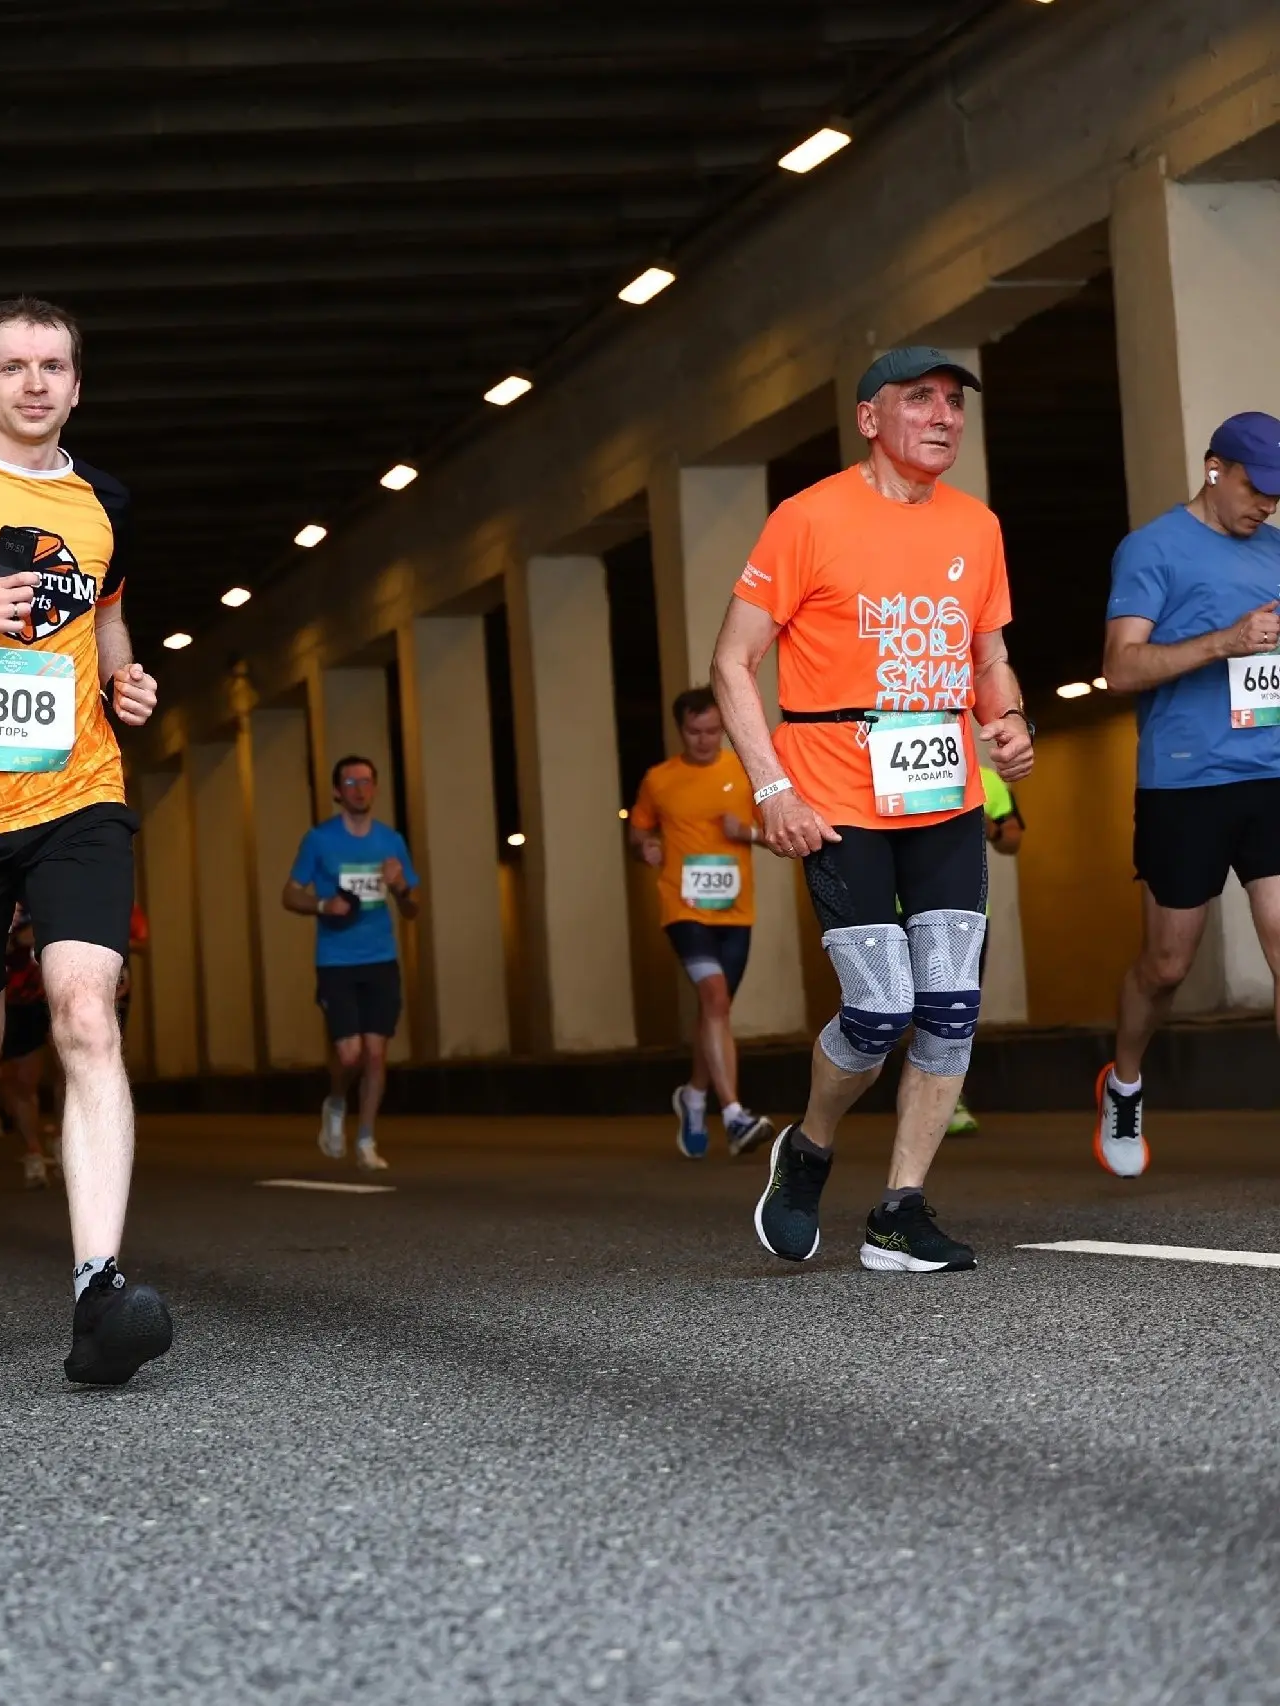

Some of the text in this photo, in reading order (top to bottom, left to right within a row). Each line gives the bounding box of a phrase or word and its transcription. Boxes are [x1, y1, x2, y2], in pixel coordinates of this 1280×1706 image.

[880, 596, 960, 625] МОС
[878, 628, 948, 656] КОВ
[1243, 665, 1280, 692] 666
[890, 736, 959, 772] 4238
[908, 770, 954, 783] РАФАИЛЬ
[759, 784, 779, 798] 4238
[690, 871, 733, 889] 7330
